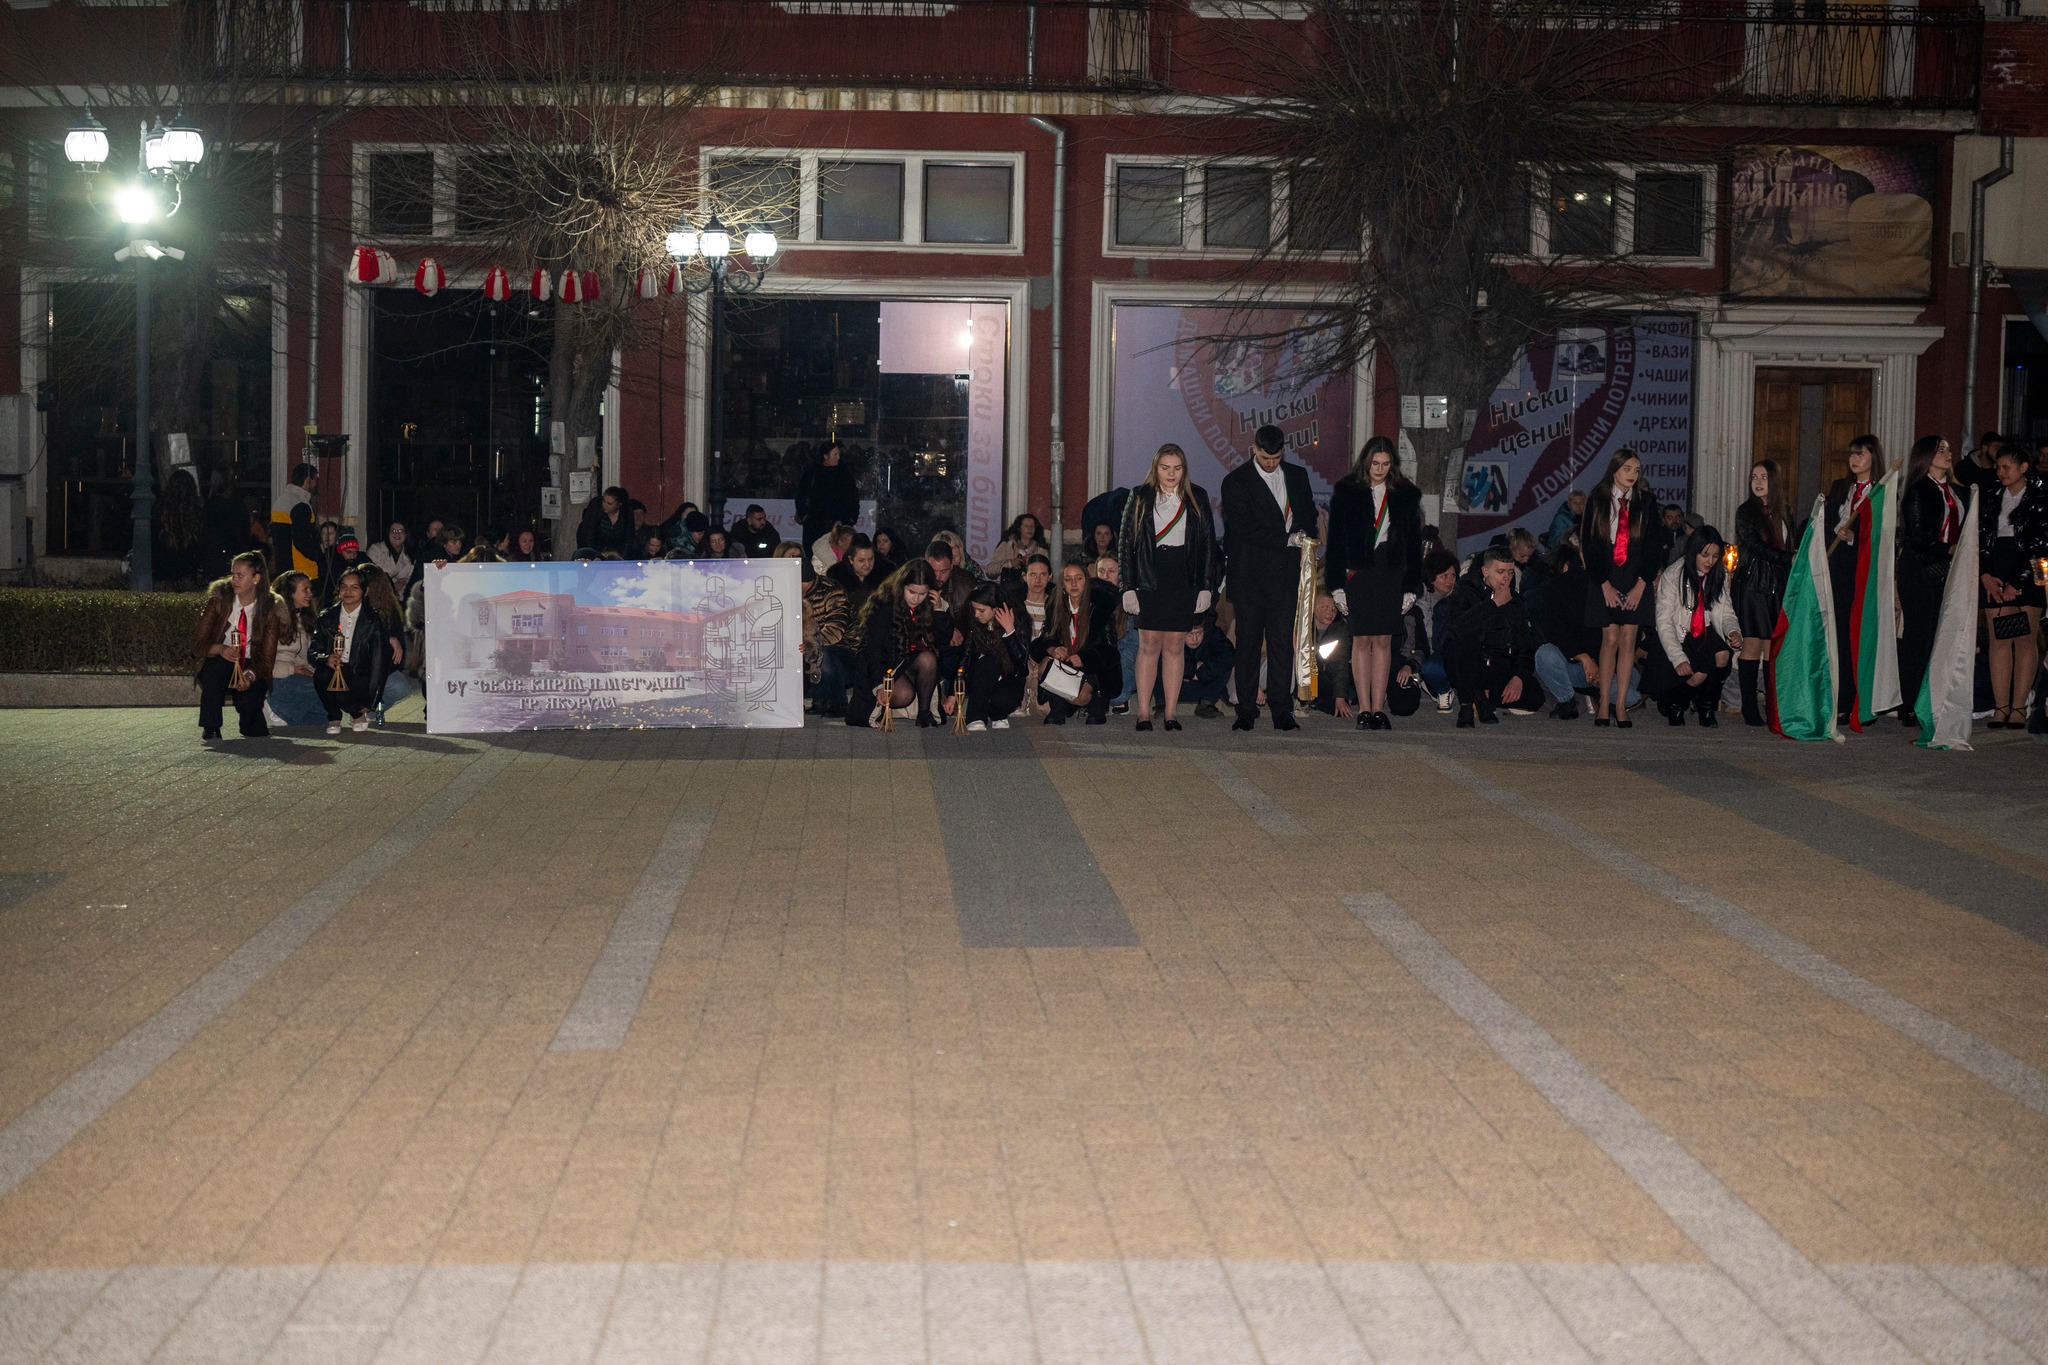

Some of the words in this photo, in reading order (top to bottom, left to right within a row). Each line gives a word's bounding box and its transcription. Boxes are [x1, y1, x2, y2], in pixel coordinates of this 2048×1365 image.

[1648, 322, 1690, 335] КОФИ
[1652, 345, 1689, 358] ВАЗИ
[974, 314, 1000, 421] Стоки
[1645, 369, 1689, 382] ЧАШИ
[1491, 385, 1569, 428] Ниски
[1637, 393, 1688, 406] ЧИНИИ
[1239, 392, 1319, 435] Ниски
[1500, 412, 1572, 456] цени!
[1639, 417, 1688, 433] ДРЕХИ
[972, 430, 992, 465] за
[1629, 440, 1687, 454] ЧОРАПИ
[1531, 416, 1613, 505] ДОМАШНИ
[970, 475, 997, 561] бита
[446, 680, 468, 697] СУ
[530, 679, 585, 692] КИРИЛ
[587, 678, 601, 691] И
[519, 698, 543, 711] ГР.
[545, 696, 617, 712] ЯКОРУДА
